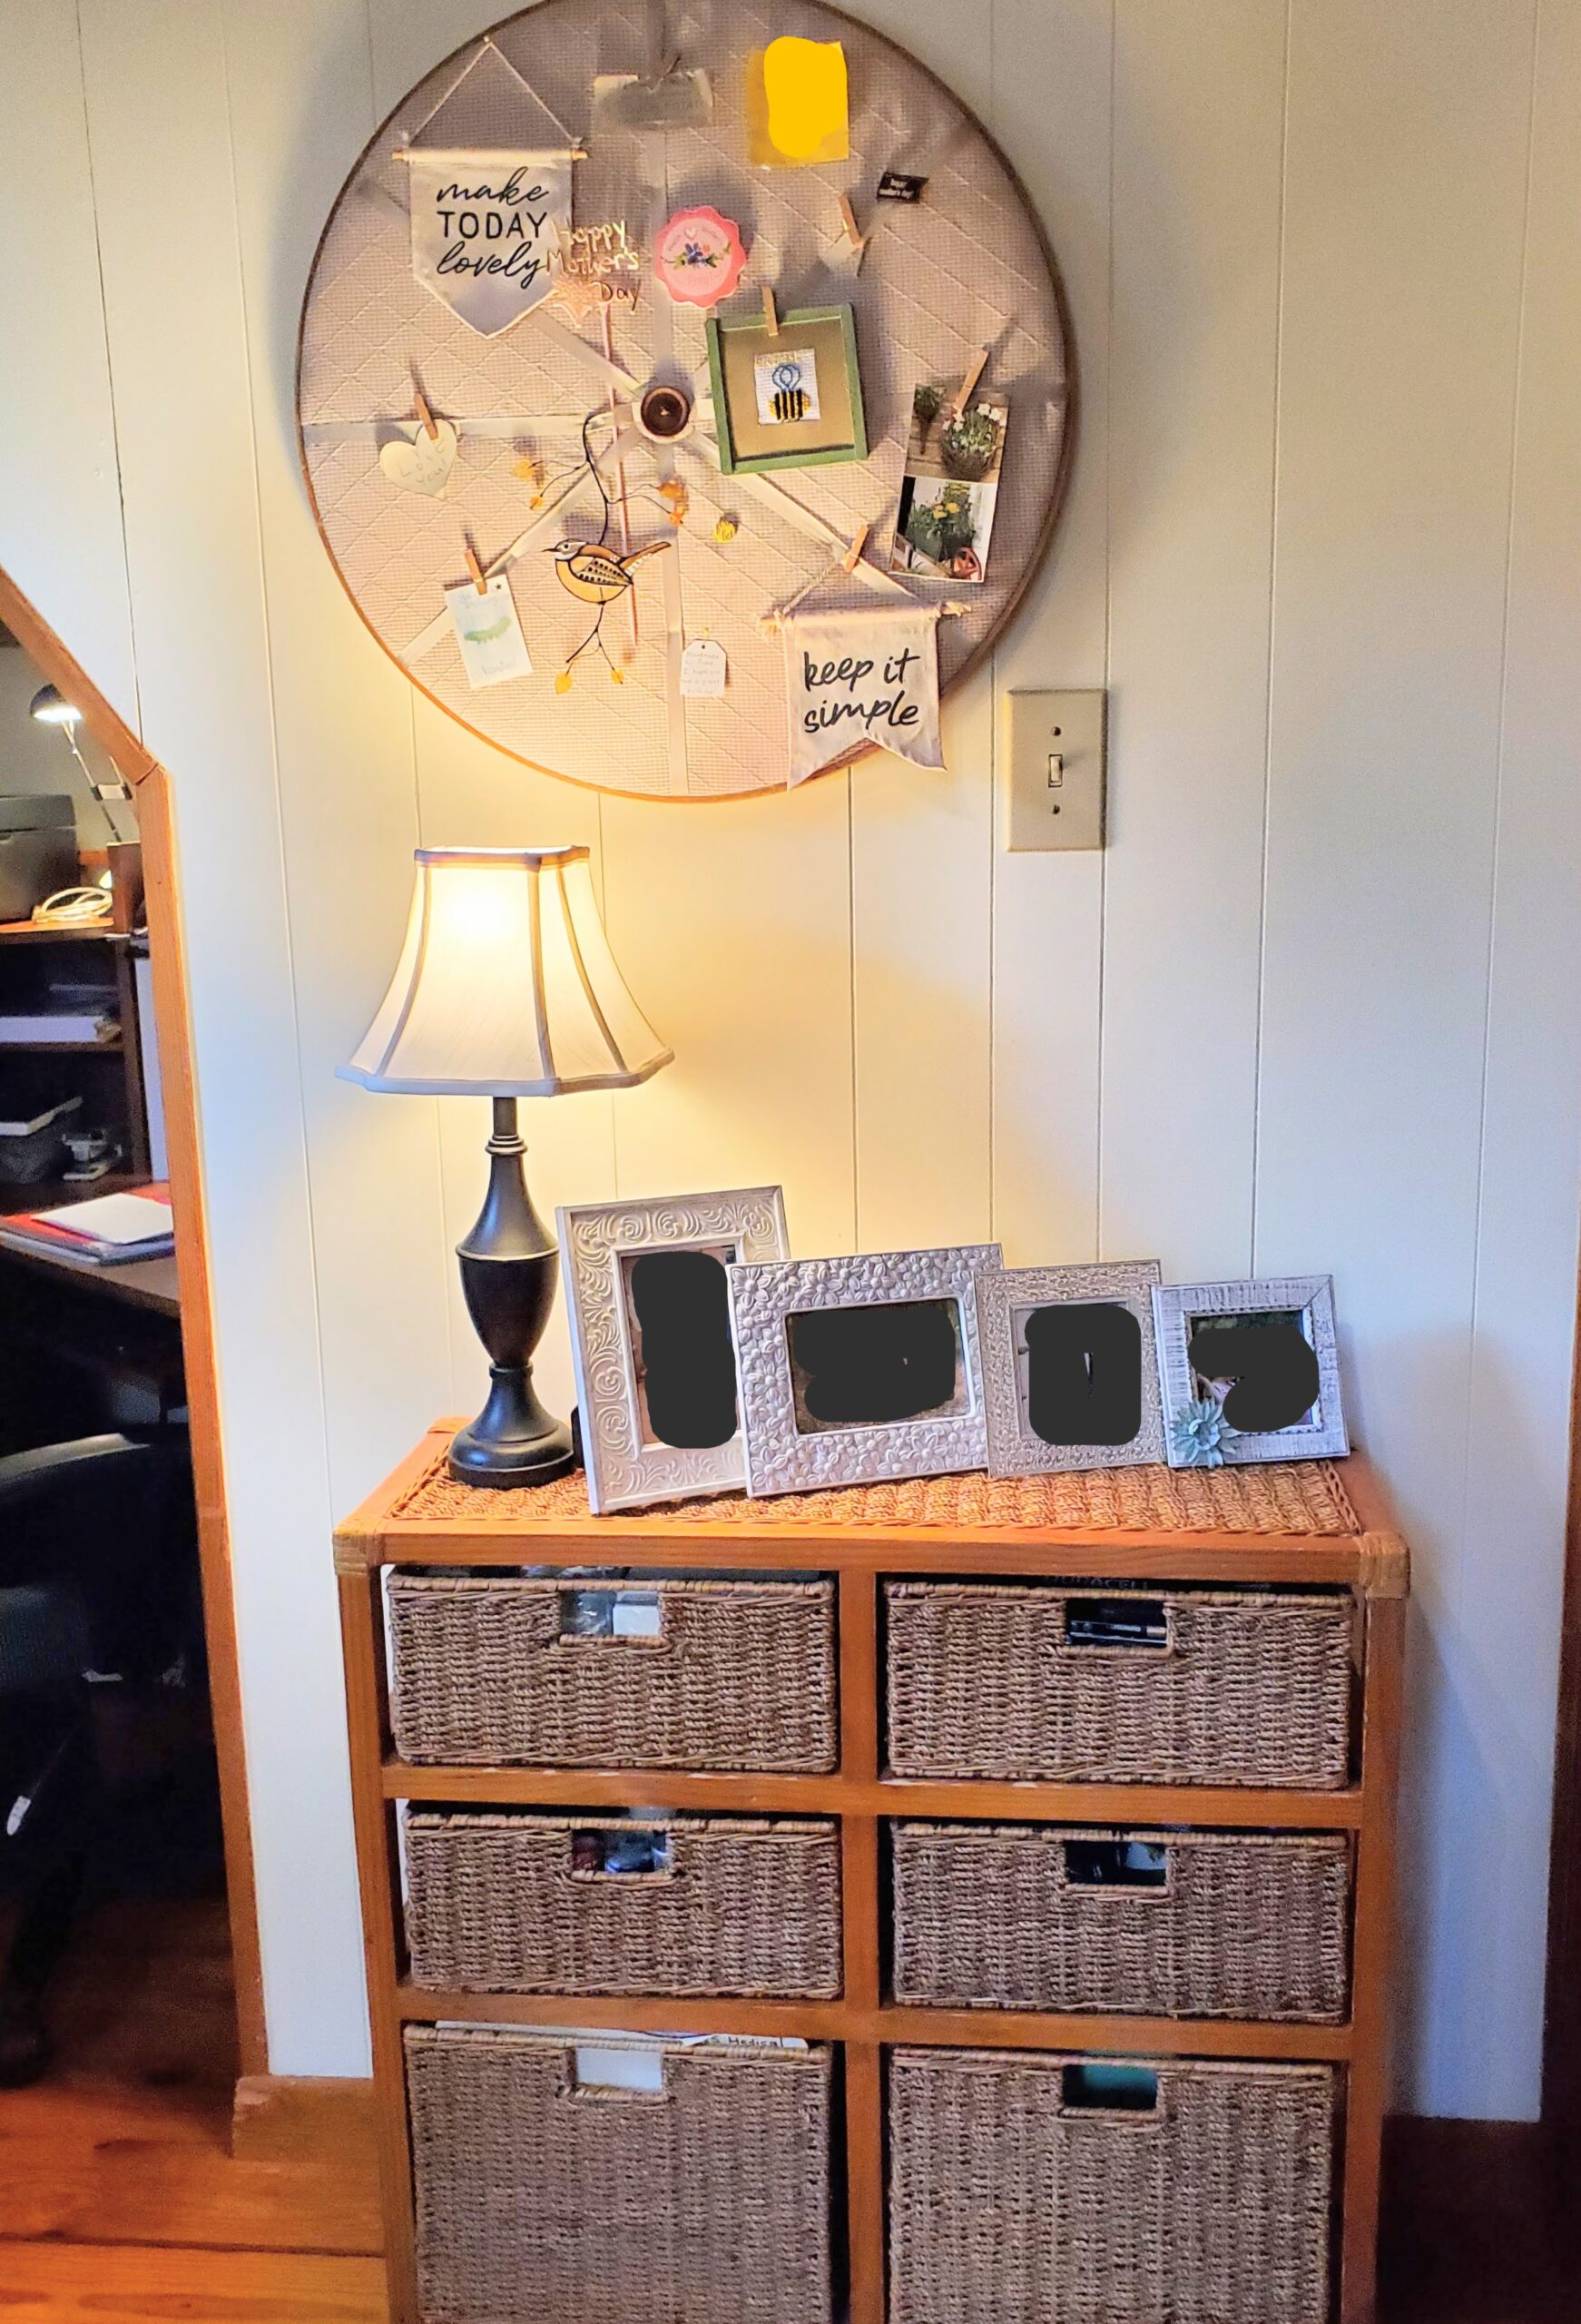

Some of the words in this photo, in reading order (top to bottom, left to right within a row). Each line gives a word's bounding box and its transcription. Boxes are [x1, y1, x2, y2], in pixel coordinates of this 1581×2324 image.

[437, 166, 549, 205] make
[437, 211, 547, 239] TODAY
[551, 219, 626, 253] Happy
[437, 241, 547, 289] lovely
[592, 279, 641, 314] Day
[803, 651, 874, 691] keep
[883, 647, 920, 684] it
[804, 690, 919, 733] simple
